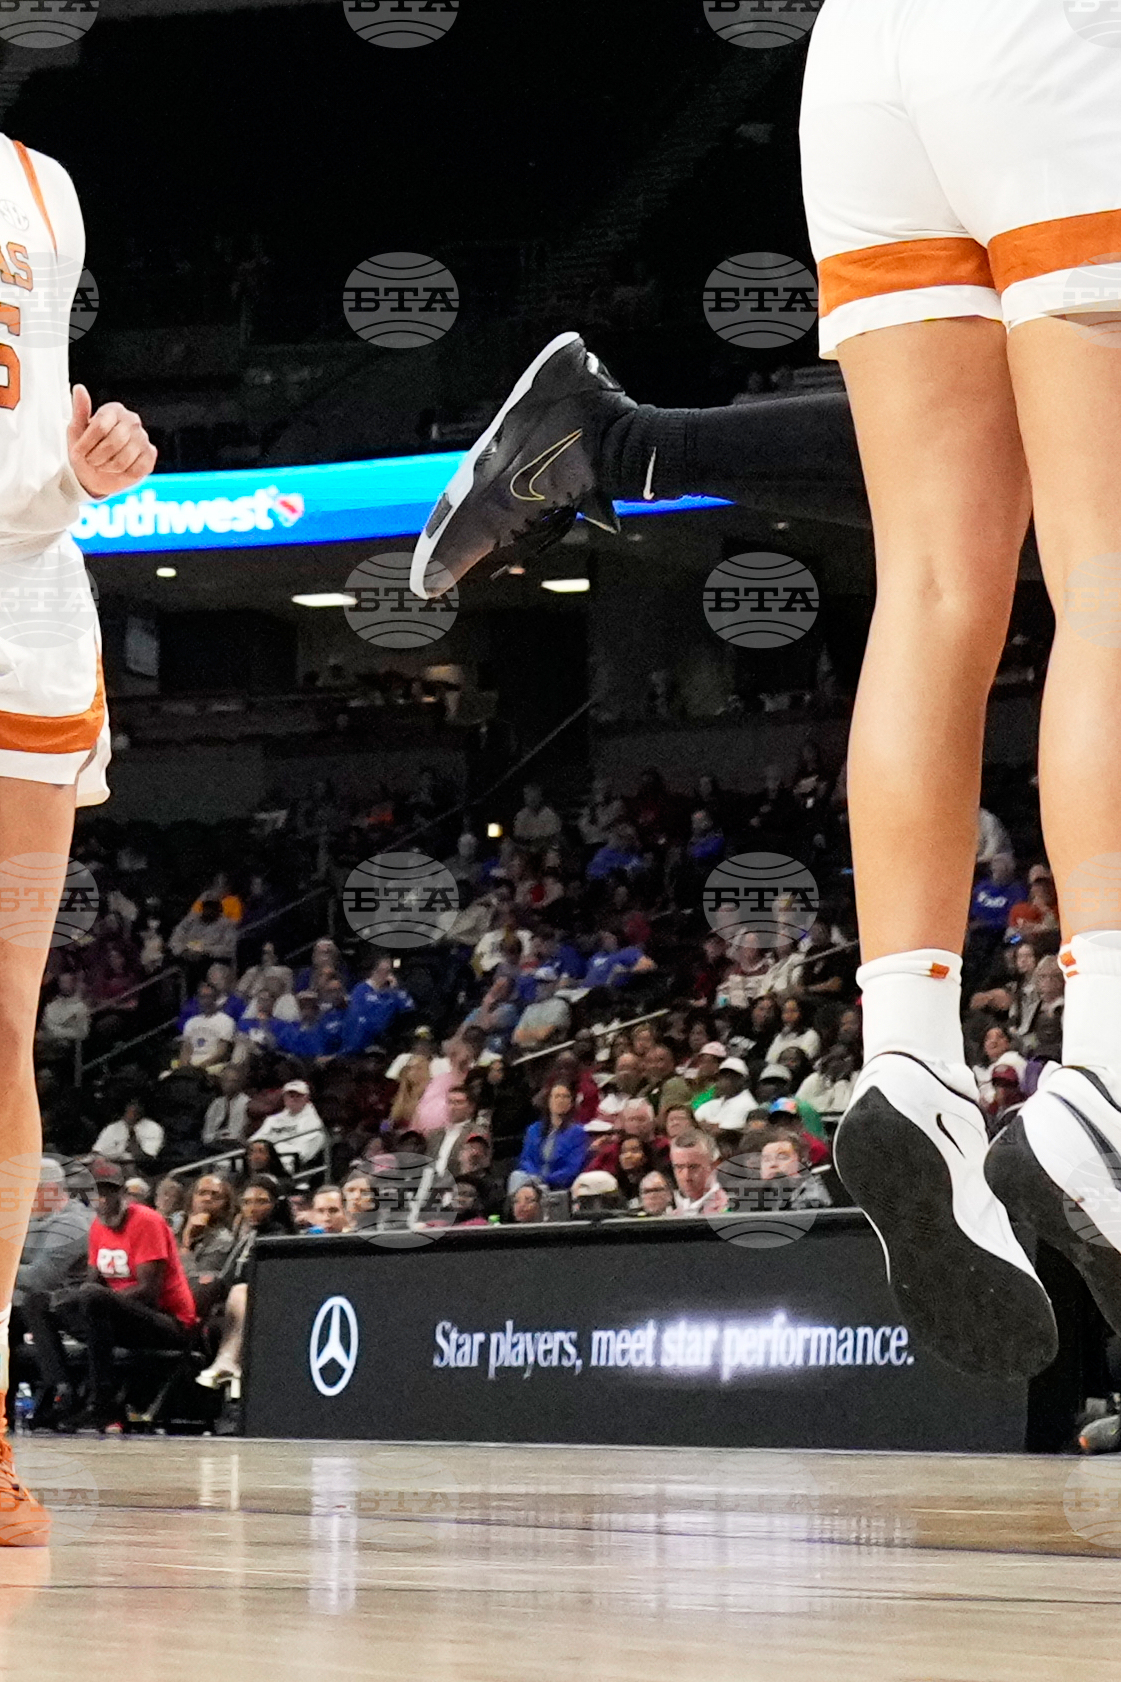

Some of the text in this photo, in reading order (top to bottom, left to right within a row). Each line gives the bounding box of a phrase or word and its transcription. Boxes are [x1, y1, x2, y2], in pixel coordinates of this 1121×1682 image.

[70, 488, 274, 539] outhwest
[433, 1310, 915, 1382] Star players, meet star performance.
